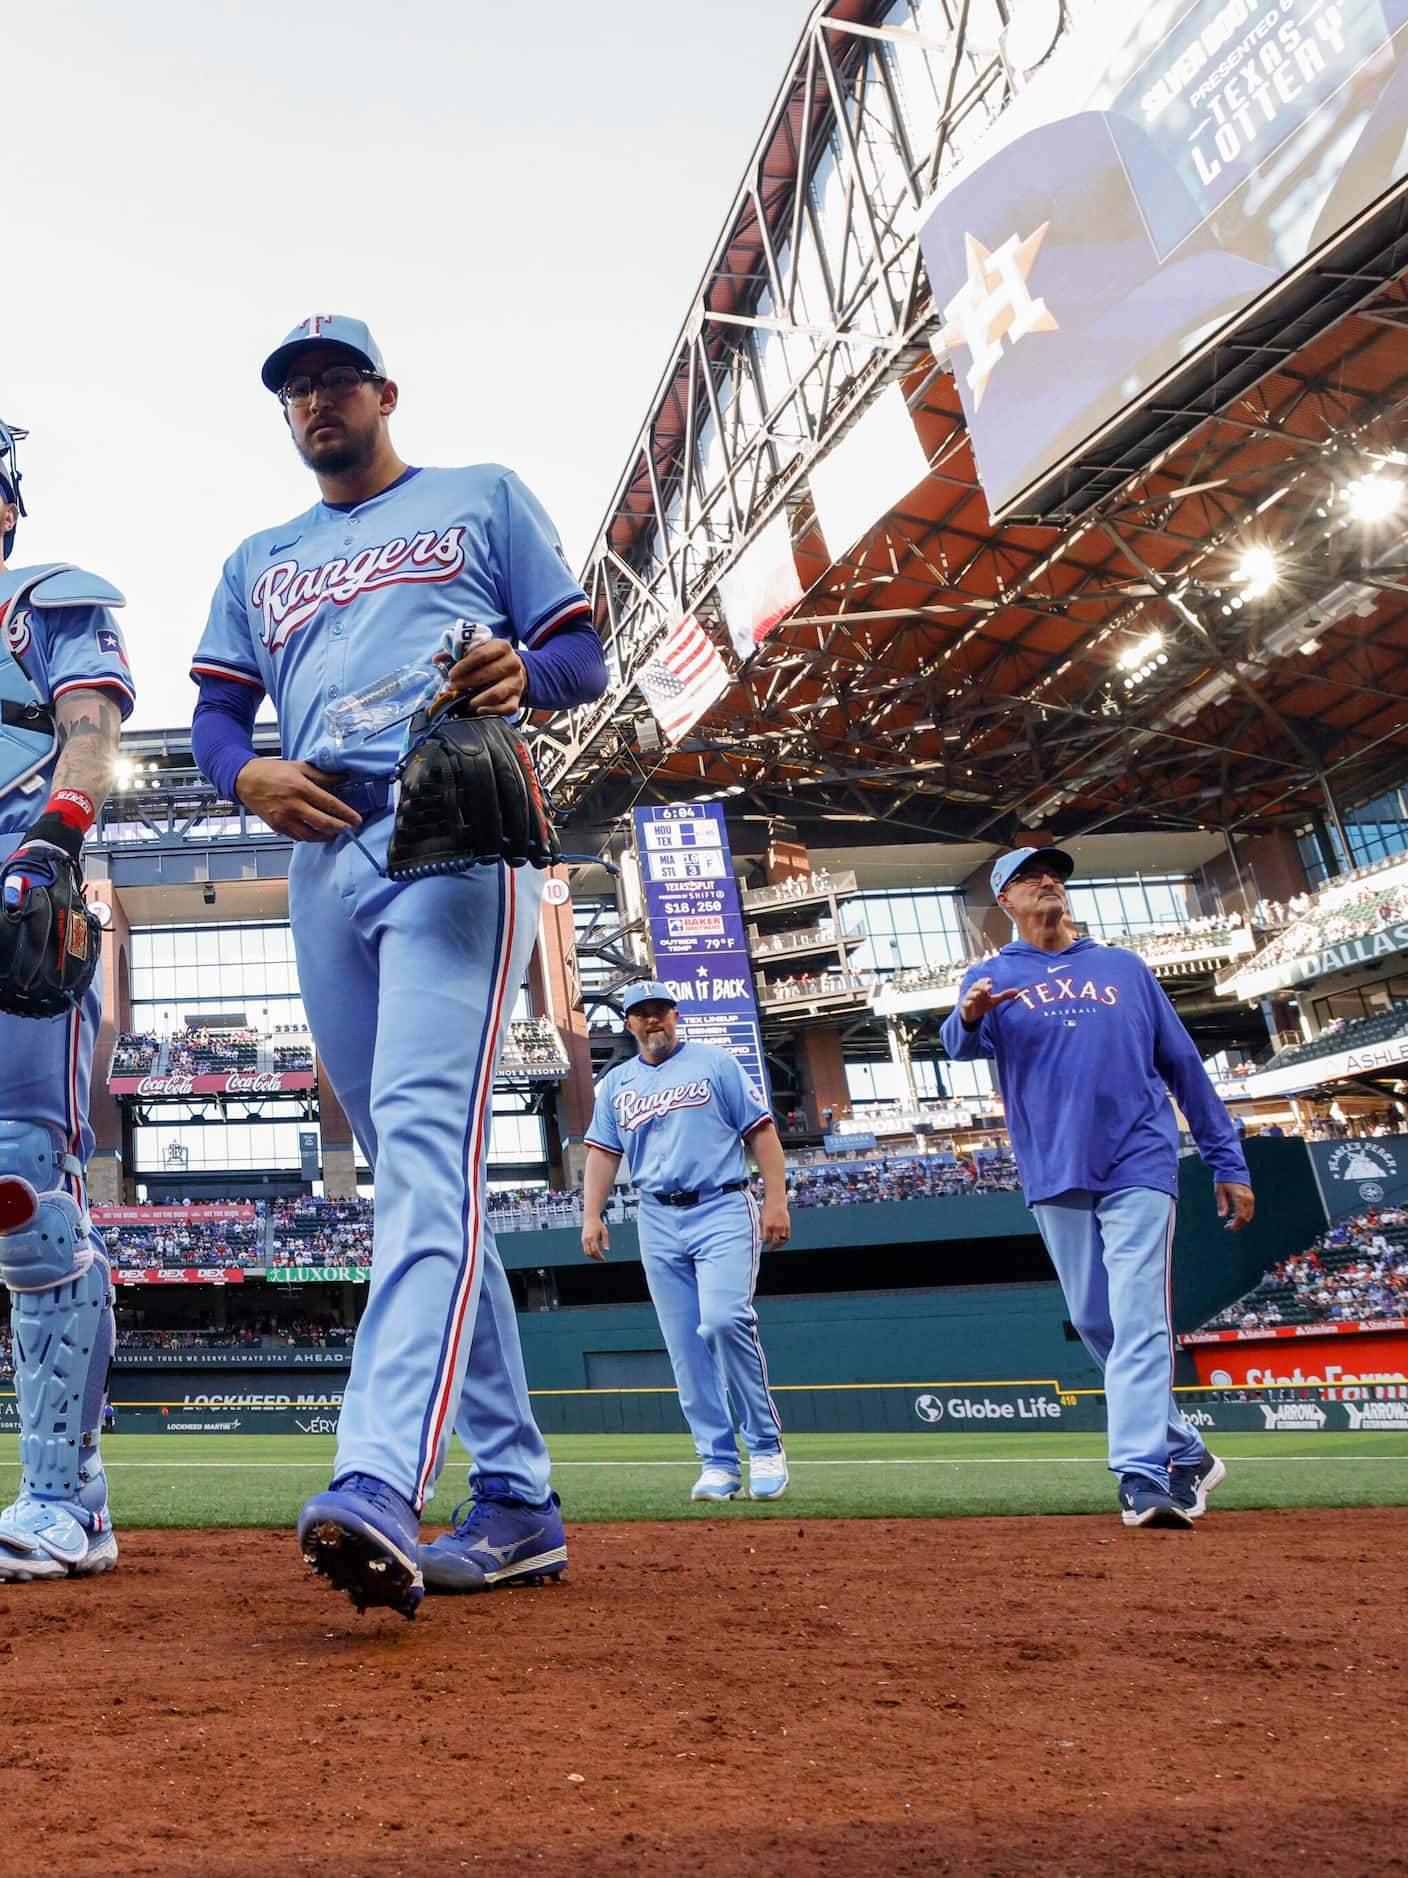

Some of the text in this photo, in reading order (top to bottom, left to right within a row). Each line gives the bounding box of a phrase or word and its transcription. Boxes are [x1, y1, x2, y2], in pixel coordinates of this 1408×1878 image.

[1190, 10, 1279, 108] PRESENTED
[1208, 20, 1302, 124] TEXAS
[1191, 5, 1345, 186] LOTTERY
[252, 526, 466, 656] Rangers
[663, 807, 695, 818] 6:04
[654, 824, 672, 835] HOU
[657, 836, 673, 846] TEX
[660, 855, 675, 865] MIA
[662, 866, 697, 877] STL 3
[665, 901, 722, 914] $18,250
[684, 917, 721, 925] BAKER
[1299, 922, 1408, 979] DALLAS
[666, 978, 750, 1002] RUN IT BACK
[1014, 978, 1120, 1011] TEXAS
[1044, 1007, 1097, 1017] BASEBALL
[138, 1075, 195, 1096] Coca-Cola
[225, 1072, 285, 1092] Coca-Cola
[614, 1078, 711, 1131] Rangers
[118, 1270, 148, 1278] DEX
[157, 1270, 187, 1278] DEX
[197, 1269, 227, 1278] DEX
[289, 1267, 352, 1281] LUXOR
[183, 1395, 290, 1411] LOCKHEED
[948, 1397, 1061, 1418] Globe Life
[1060, 1395, 1077, 1405] 410
[1277, 1403, 1315, 1419] ARROW
[1362, 1403, 1407, 1419] ARROW
